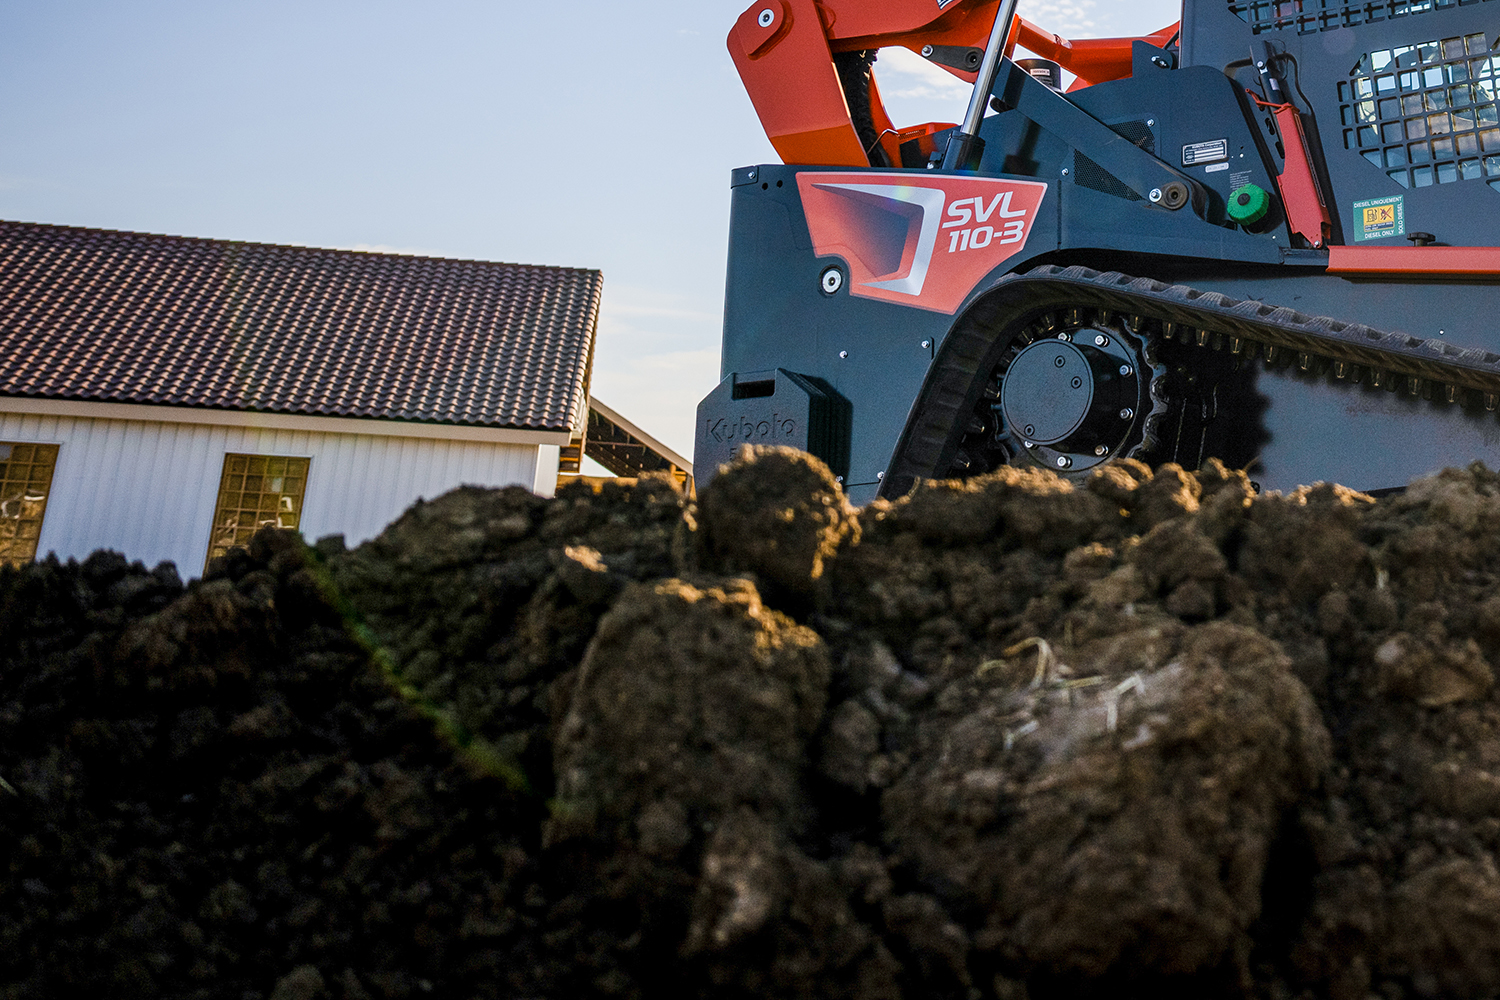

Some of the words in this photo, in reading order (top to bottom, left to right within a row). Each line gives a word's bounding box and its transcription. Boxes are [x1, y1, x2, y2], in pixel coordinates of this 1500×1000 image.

[942, 191, 1026, 228] SVL
[1371, 197, 1402, 205] UNIQUEMENT
[948, 220, 1025, 253] 110-3
[1364, 231, 1381, 239] DIESEL
[705, 413, 796, 443] Kubota
